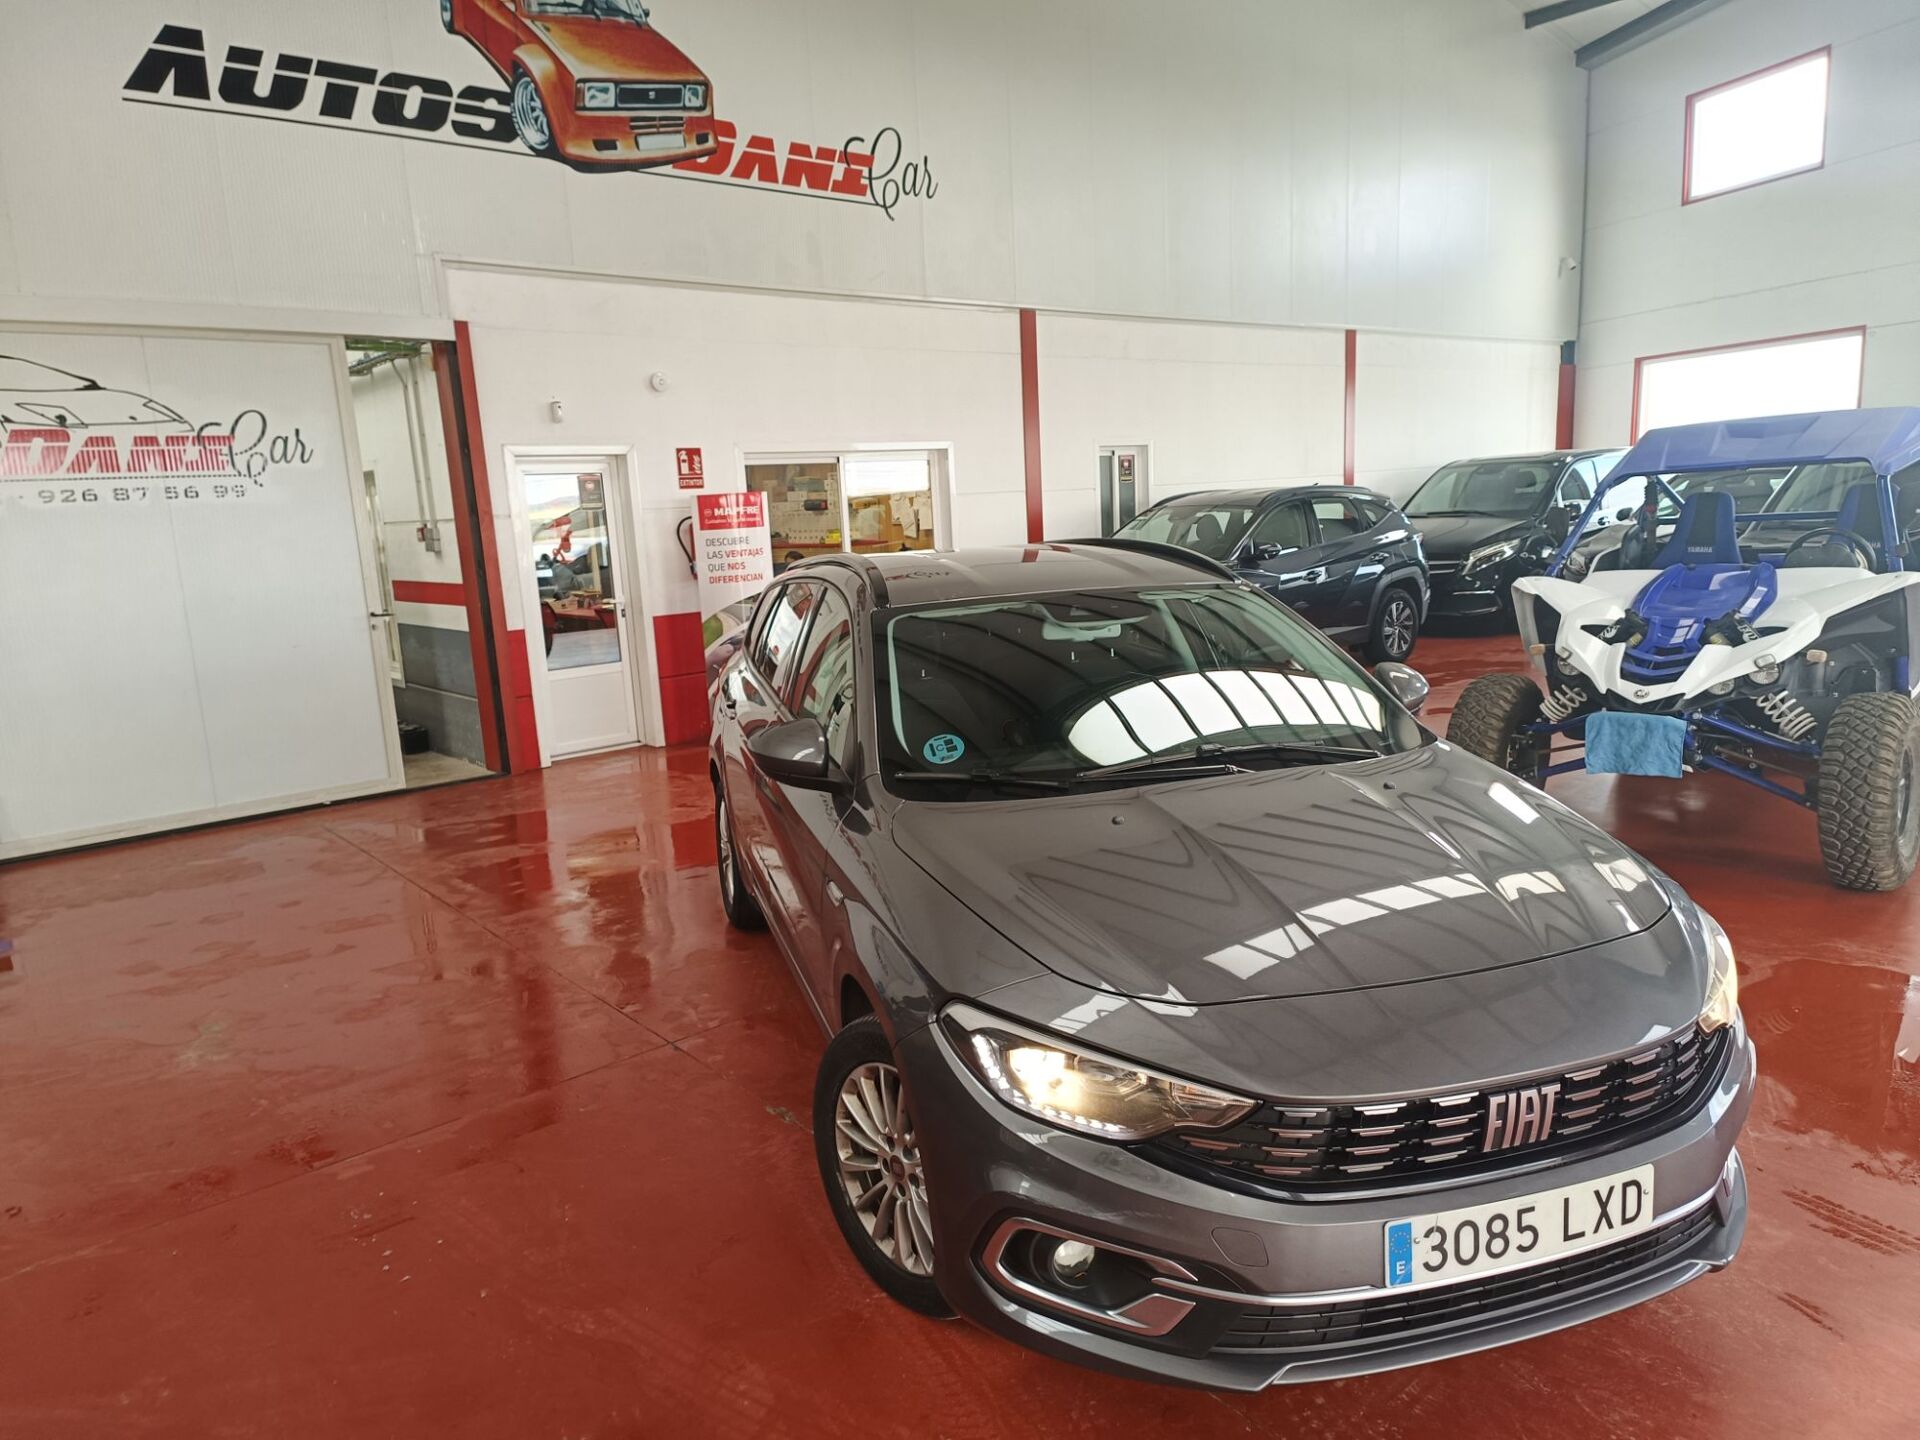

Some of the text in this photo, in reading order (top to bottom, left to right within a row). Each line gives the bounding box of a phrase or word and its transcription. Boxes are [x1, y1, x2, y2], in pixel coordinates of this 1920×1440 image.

[123, 24, 938, 221] AUTOS DANI Car
[1, 410, 313, 487] DANI Car
[37, 489, 98, 503] 926
[113, 487, 149, 501] 87
[164, 485, 199, 500] 56
[713, 506, 759, 517] MAPFRE
[706, 547, 764, 560] LAS VENTAJAS
[708, 561, 746, 573] QUE NOS
[709, 573, 763, 584] DIFERENCIAN
[1483, 1083, 1561, 1153] FIAT
[1396, 1178, 1643, 1275] E 3085 LXD
